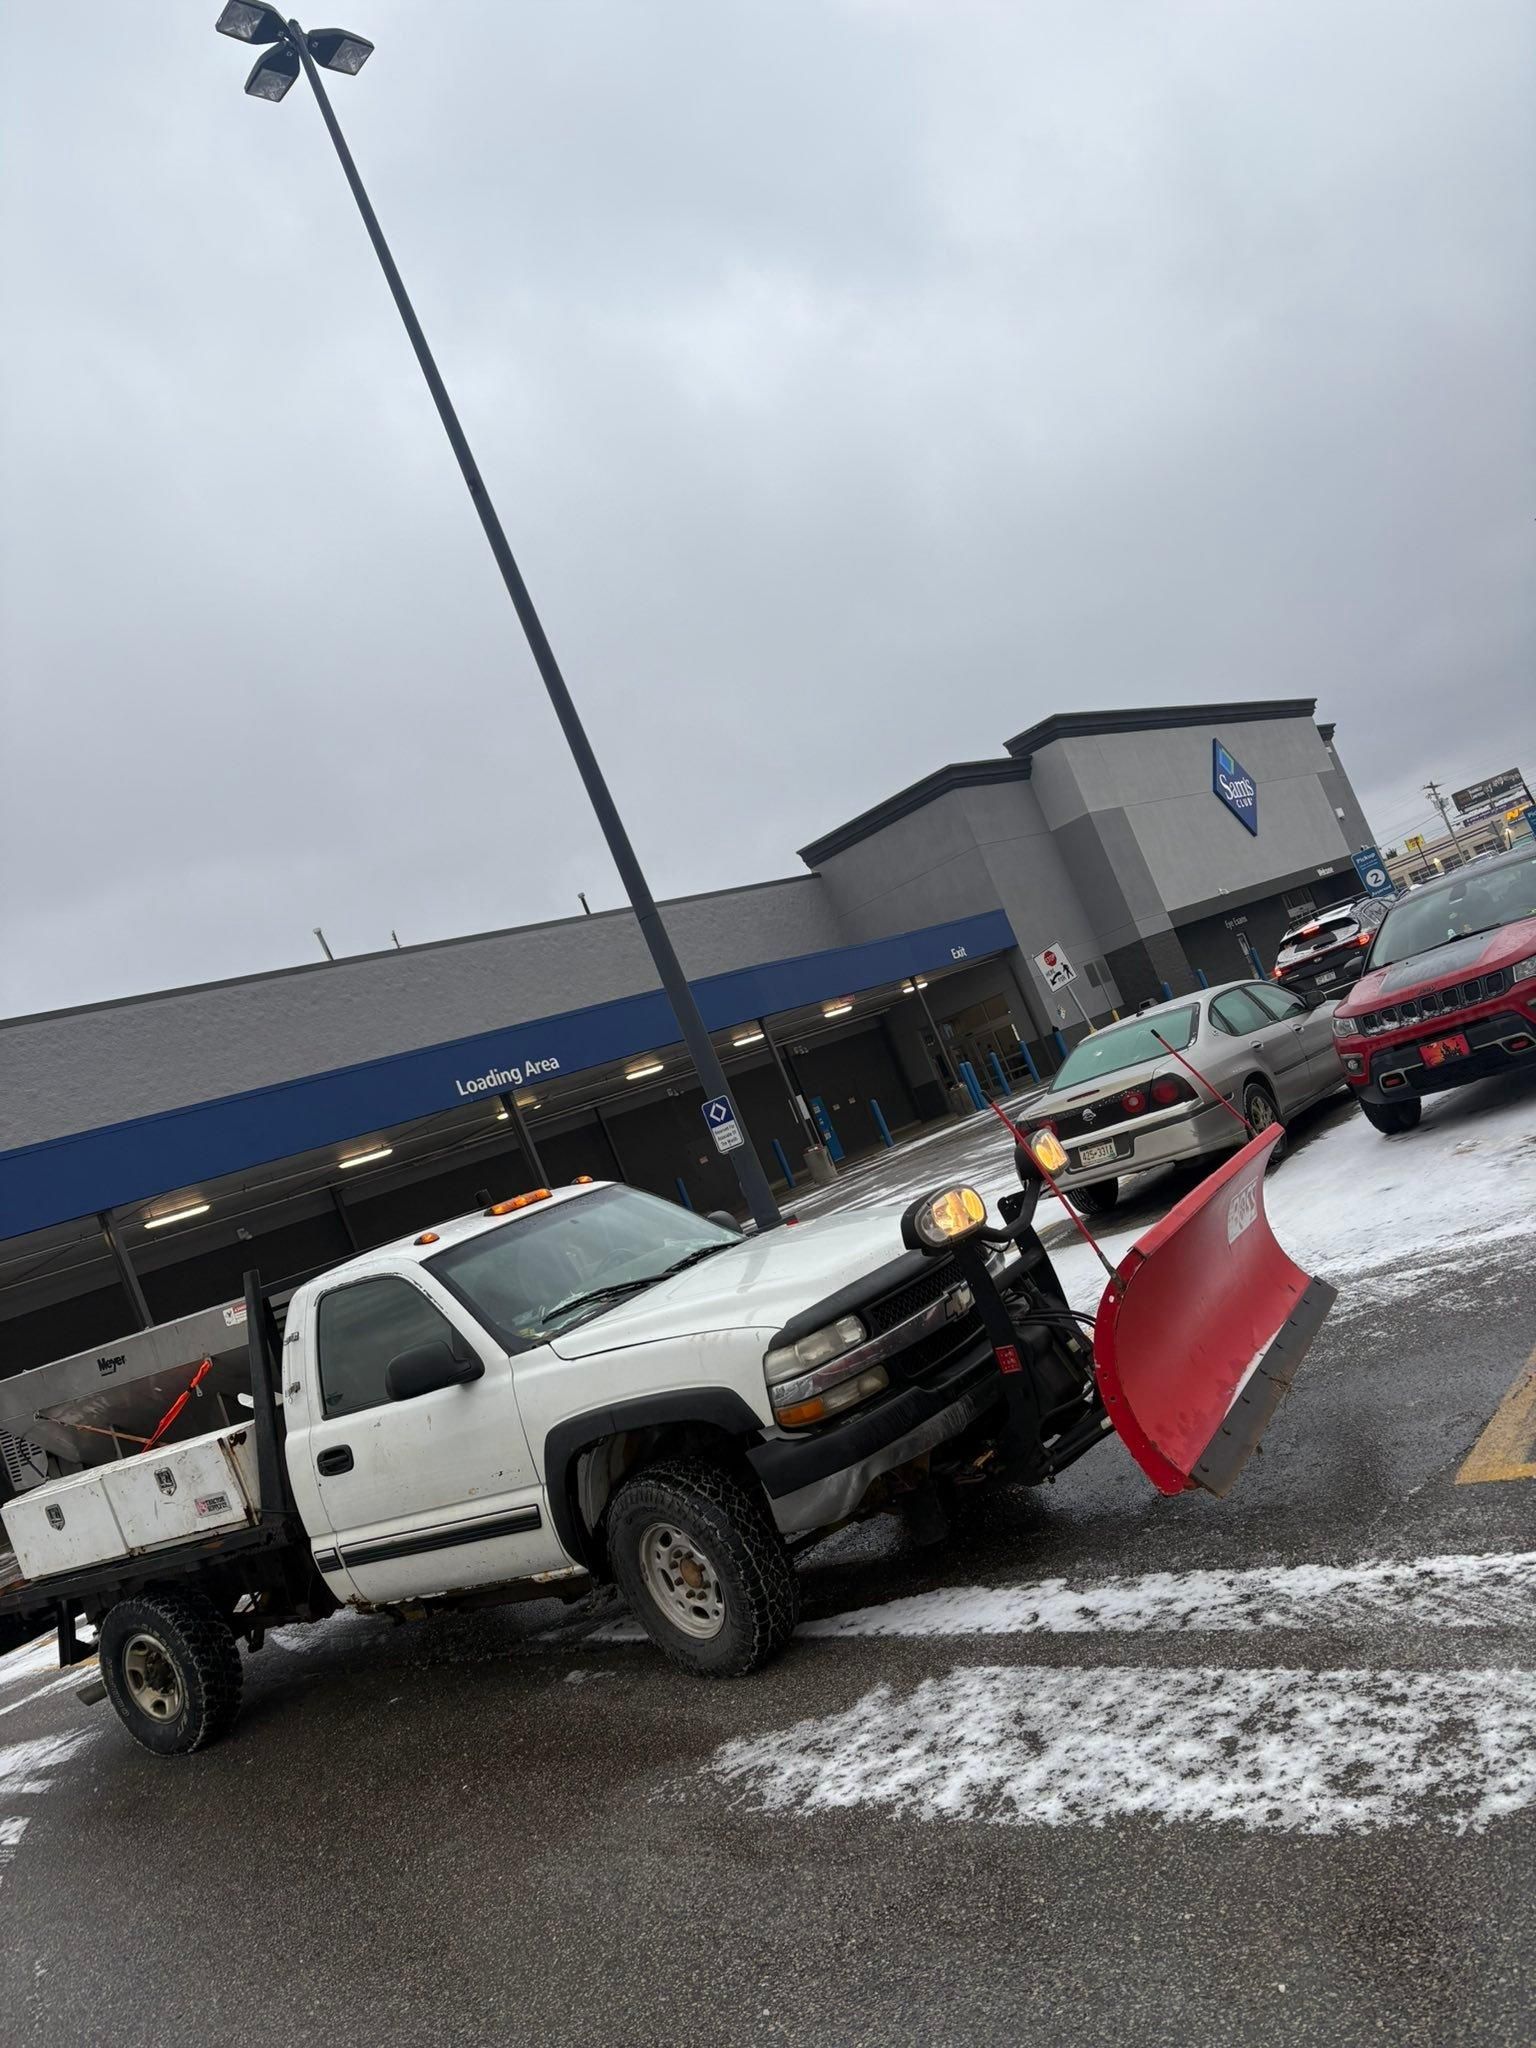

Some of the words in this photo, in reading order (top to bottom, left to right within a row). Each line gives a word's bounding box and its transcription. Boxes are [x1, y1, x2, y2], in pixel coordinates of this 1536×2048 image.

[1236, 797, 1253, 808] CLUB
[1370, 872, 1382, 884] 2
[950, 945, 968, 959] Exit
[455, 1069, 523, 1096] Loading
[525, 1057, 560, 1077] Area
[97, 1355, 126, 1376] Meyer
